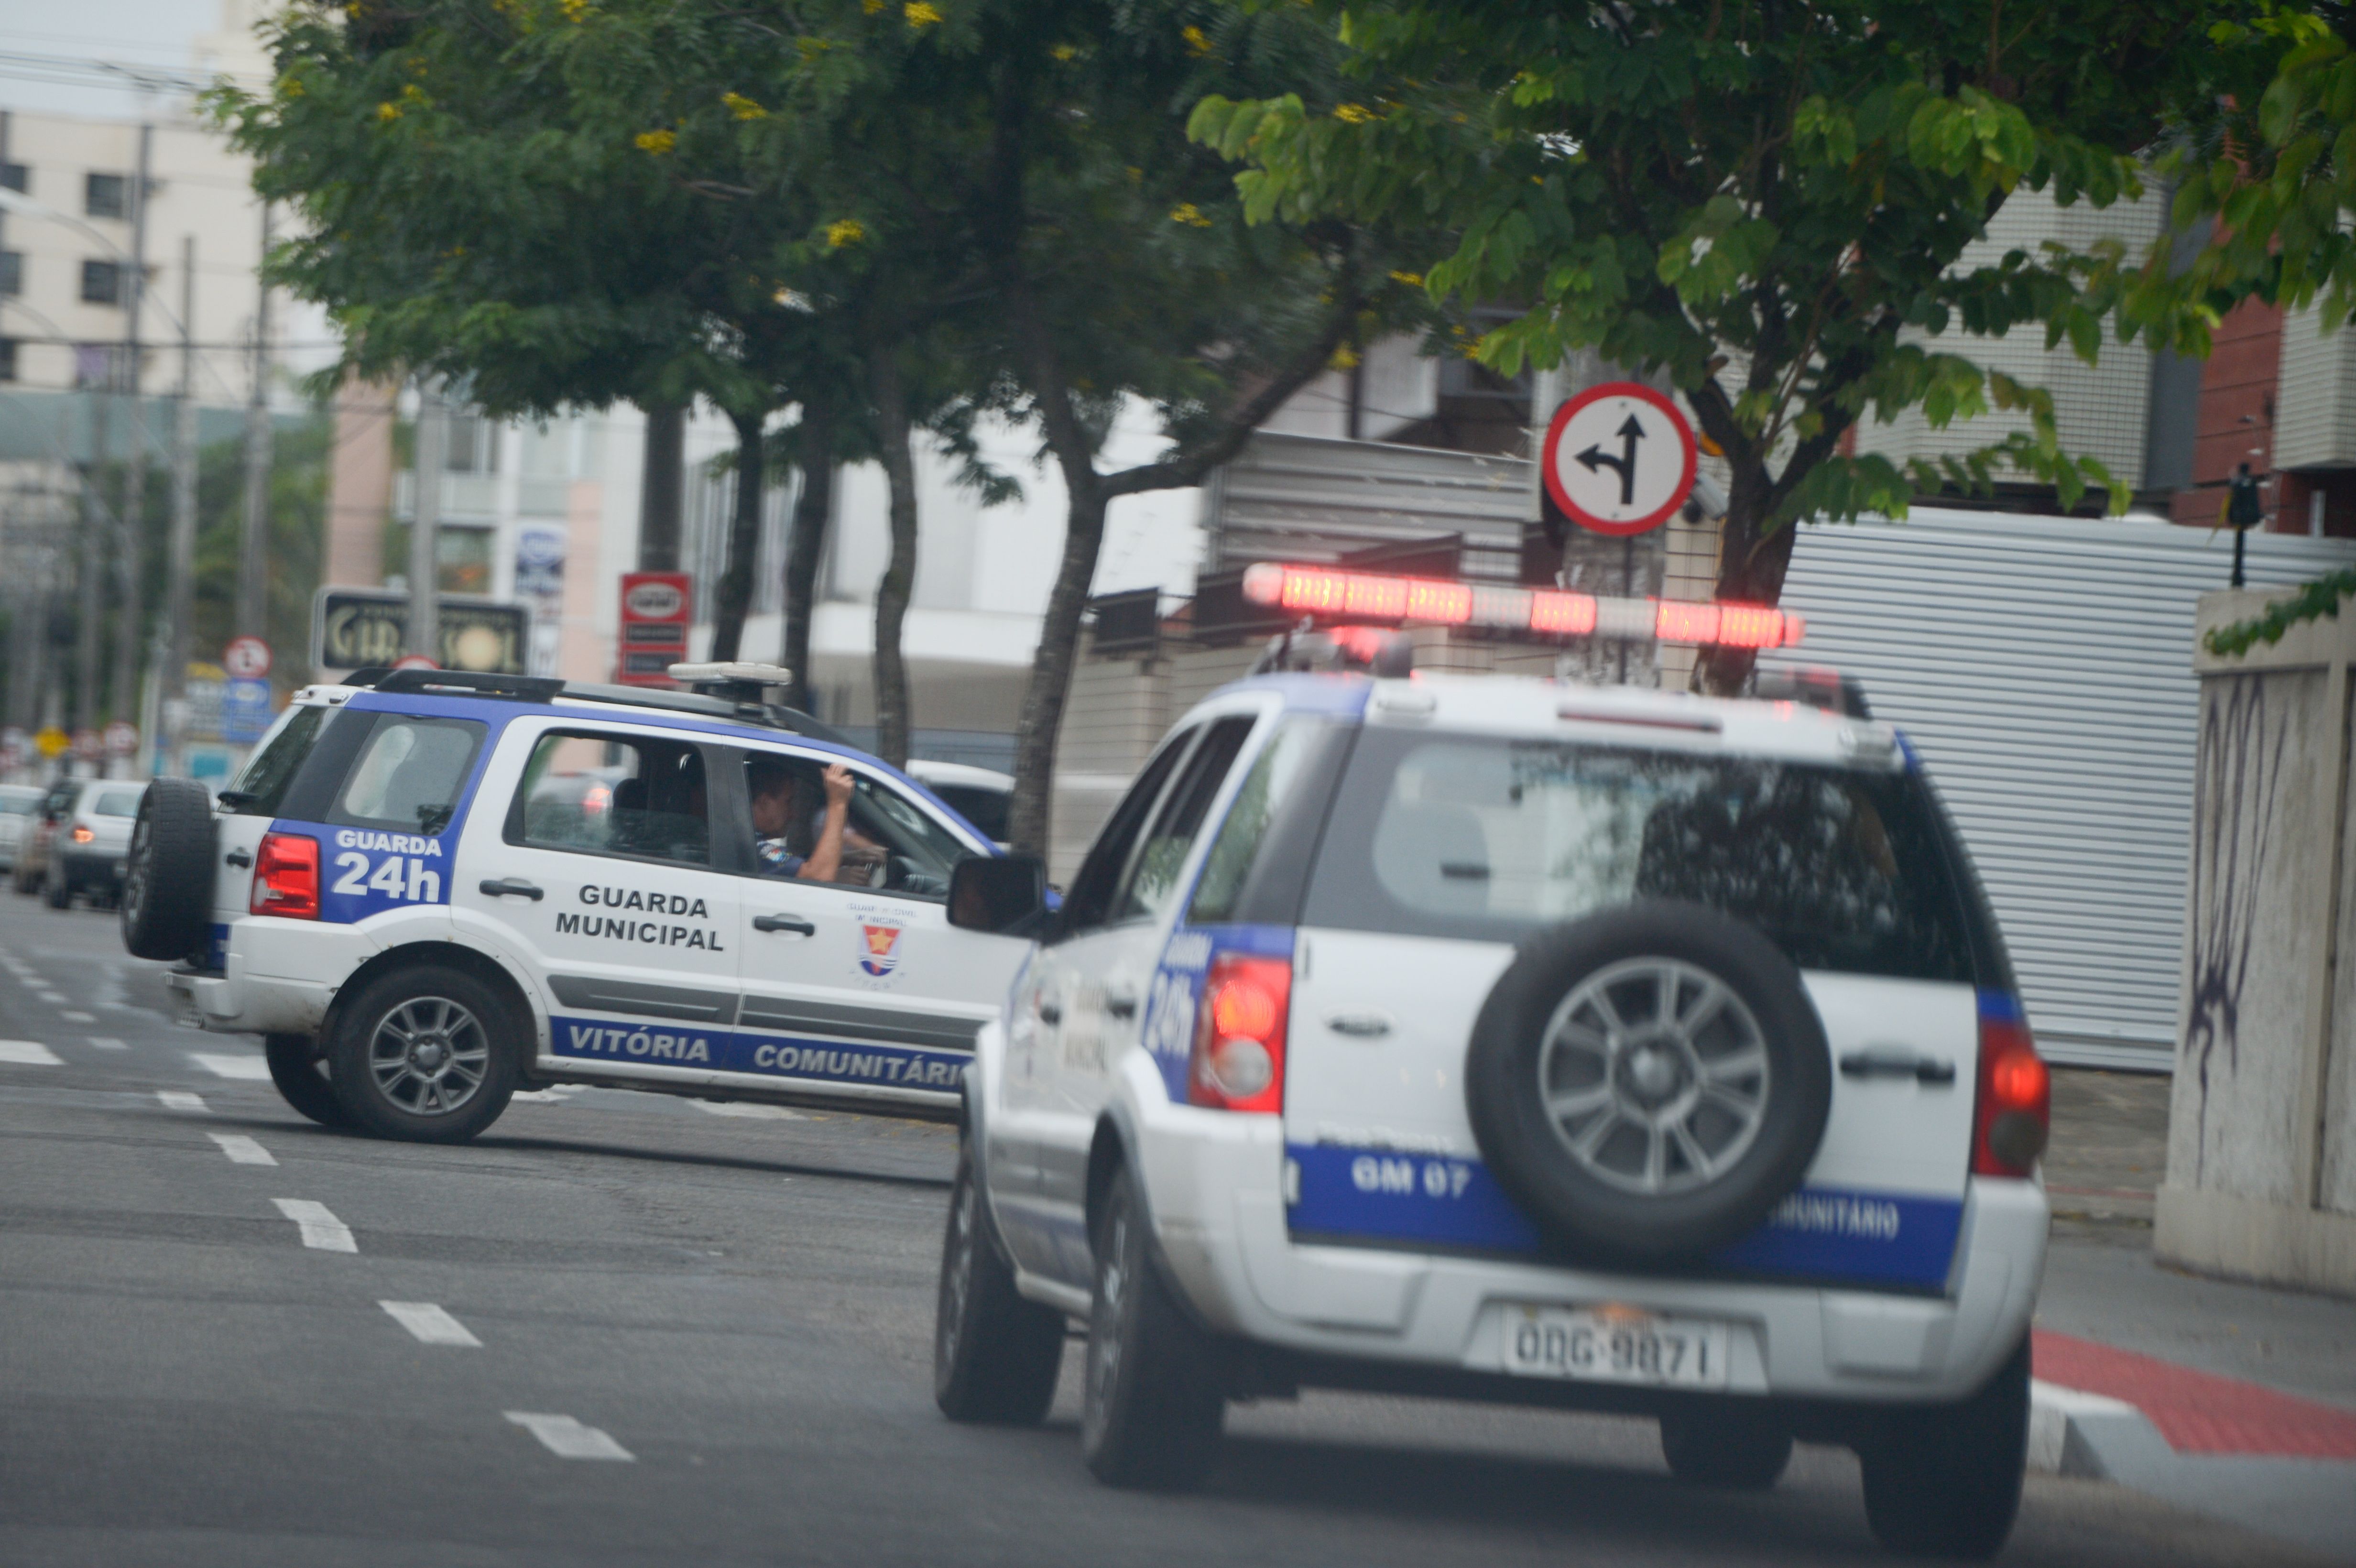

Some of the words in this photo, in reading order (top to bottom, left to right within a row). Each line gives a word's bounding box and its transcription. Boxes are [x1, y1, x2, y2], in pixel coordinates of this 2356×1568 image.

[336, 829, 442, 857] GUARDA
[331, 851, 440, 903] 24h
[579, 884, 709, 919] GUARDA
[855, 914, 907, 926] MNICIPAL
[556, 913, 724, 951] MUNICIPAL
[569, 1025, 710, 1063] VITÓRIA
[1351, 1154, 1415, 1195] GM
[1423, 1159, 1472, 1199] 07
[1770, 1192, 1900, 1242] MUNITÁRIO
